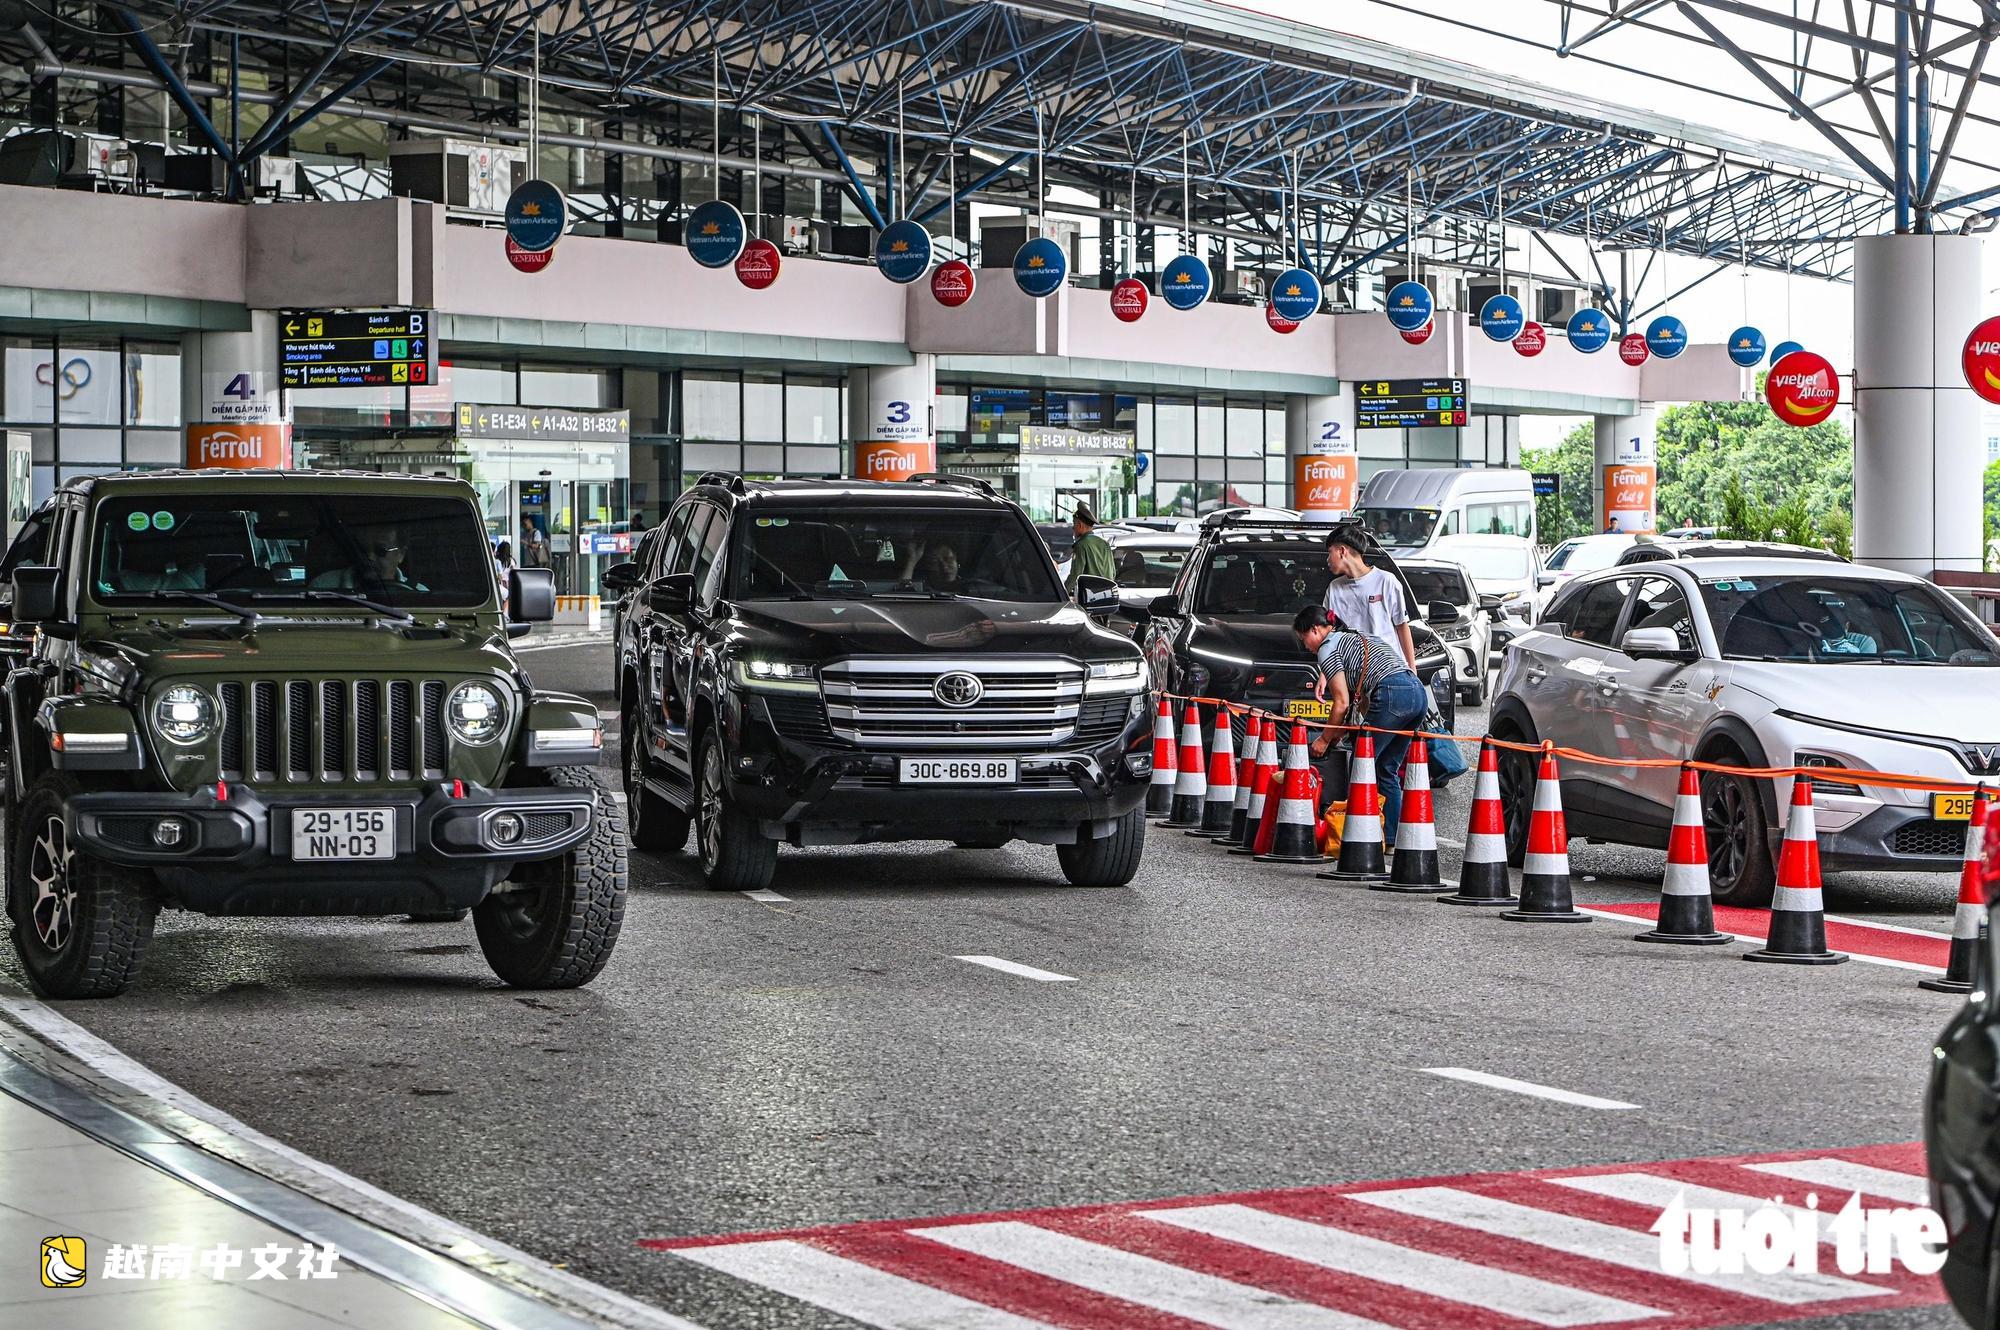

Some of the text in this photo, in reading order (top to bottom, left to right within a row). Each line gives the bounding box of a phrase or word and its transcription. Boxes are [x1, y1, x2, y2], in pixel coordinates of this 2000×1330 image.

[510, 254, 546, 263] GENERALI
[740, 271, 772, 280] GENERALI
[936, 290, 967, 298] GENERALI
[1114, 306, 1142, 314] GENERALI
[368, 326, 395, 335] Departure
[410, 314, 423, 334] B
[1516, 343, 1542, 351] GENERALI
[300, 366, 308, 384] 1
[310, 376, 326, 384] Arrival
[224, 374, 256, 400] 4
[1452, 380, 1463, 394] B
[887, 401, 911, 424] 3
[491, 414, 617, 433] E1-E34 A1-A32 B1-B32
[1372, 414, 1378, 426] 1
[1322, 422, 1340, 440] 2
[1042, 436, 1066, 448] E1-E34
[1076, 436, 1100, 448] A1-A32
[1102, 437, 1126, 449] B1-B32
[1630, 438, 1640, 452] 1
[910, 762, 1008, 778] 30C-869.88
[303, 812, 384, 833] 29-156
[310, 835, 377, 857] NN-03
